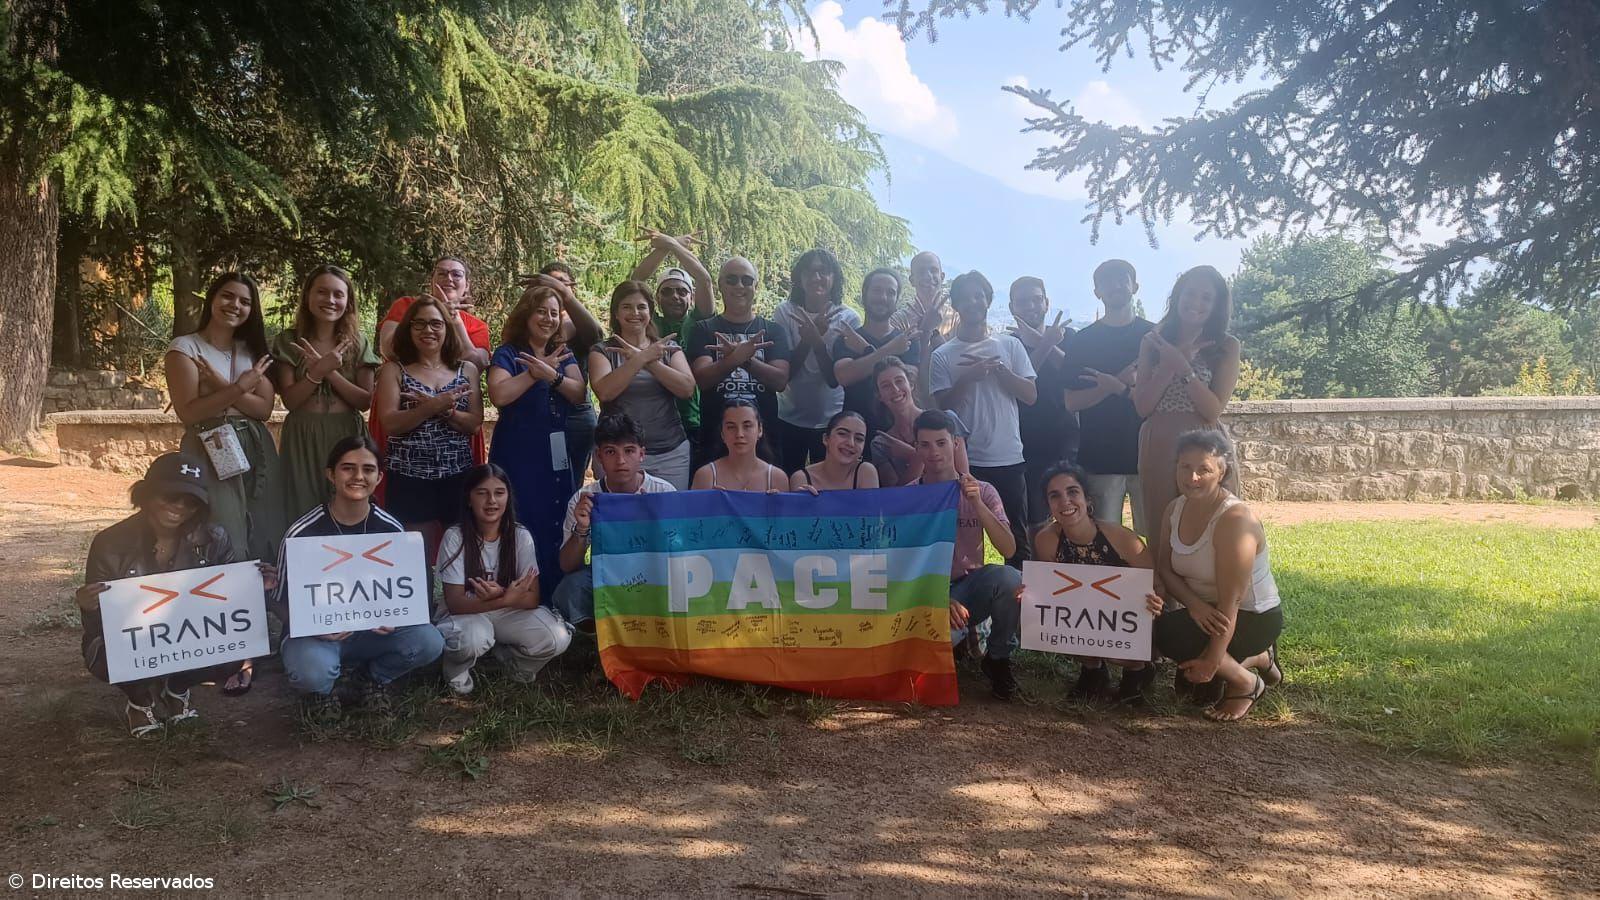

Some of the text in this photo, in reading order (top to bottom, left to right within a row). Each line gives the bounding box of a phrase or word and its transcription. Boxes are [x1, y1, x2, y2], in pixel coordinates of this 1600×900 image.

[716, 382, 766, 393] PORTO
[304, 576, 415, 607] TRANS
[667, 553, 888, 612] PACE
[122, 608, 252, 651] TRANS
[312, 605, 409, 626] lighthouses
[1035, 604, 1138, 633] TRANS
[134, 639, 247, 670] lighthouses
[1040, 632, 1131, 650] lighthouses
